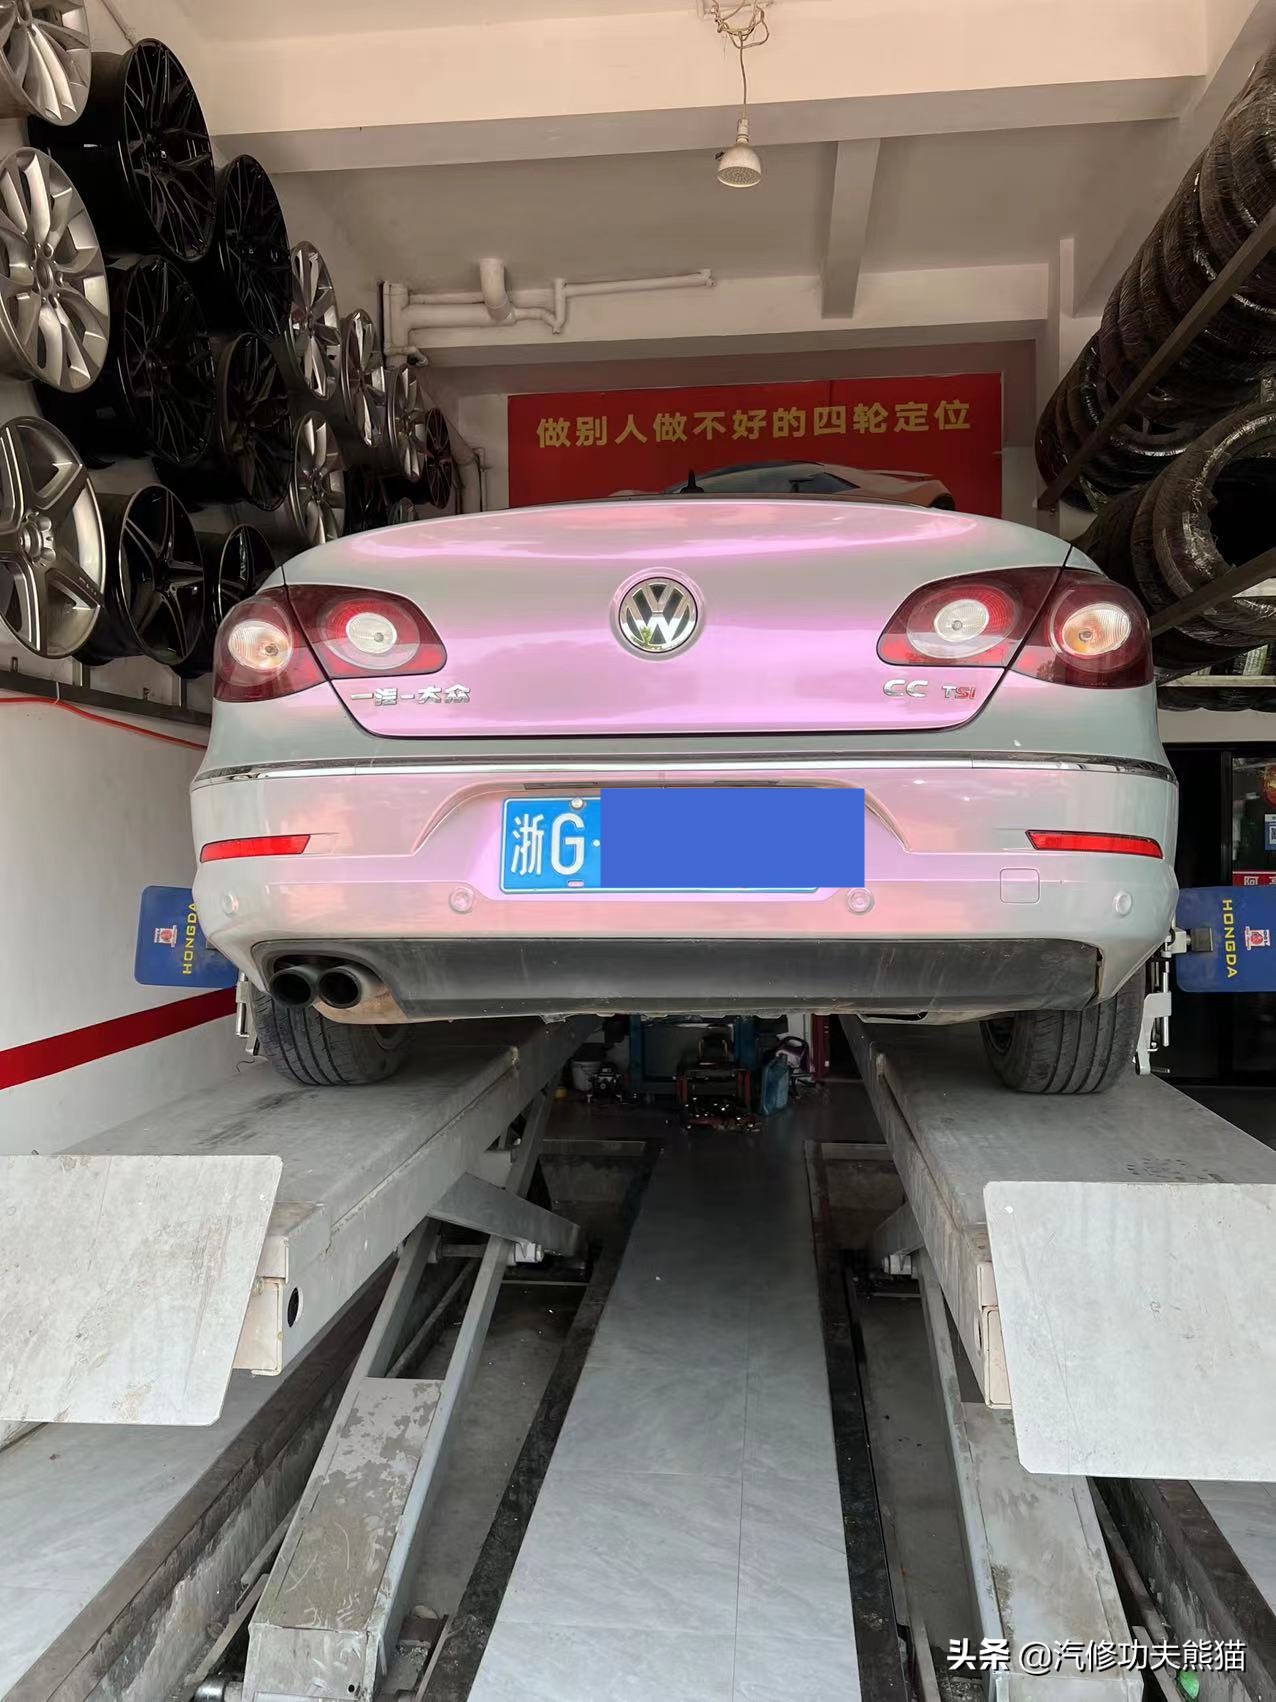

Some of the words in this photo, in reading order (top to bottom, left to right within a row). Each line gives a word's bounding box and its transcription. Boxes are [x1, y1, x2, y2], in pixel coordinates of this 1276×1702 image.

[536, 399, 972, 448] 做别人做不好的四轮定位
[883, 679, 928, 697] CC
[182, 903, 198, 975] HONGDA
[1222, 899, 1238, 978] HONGDA
